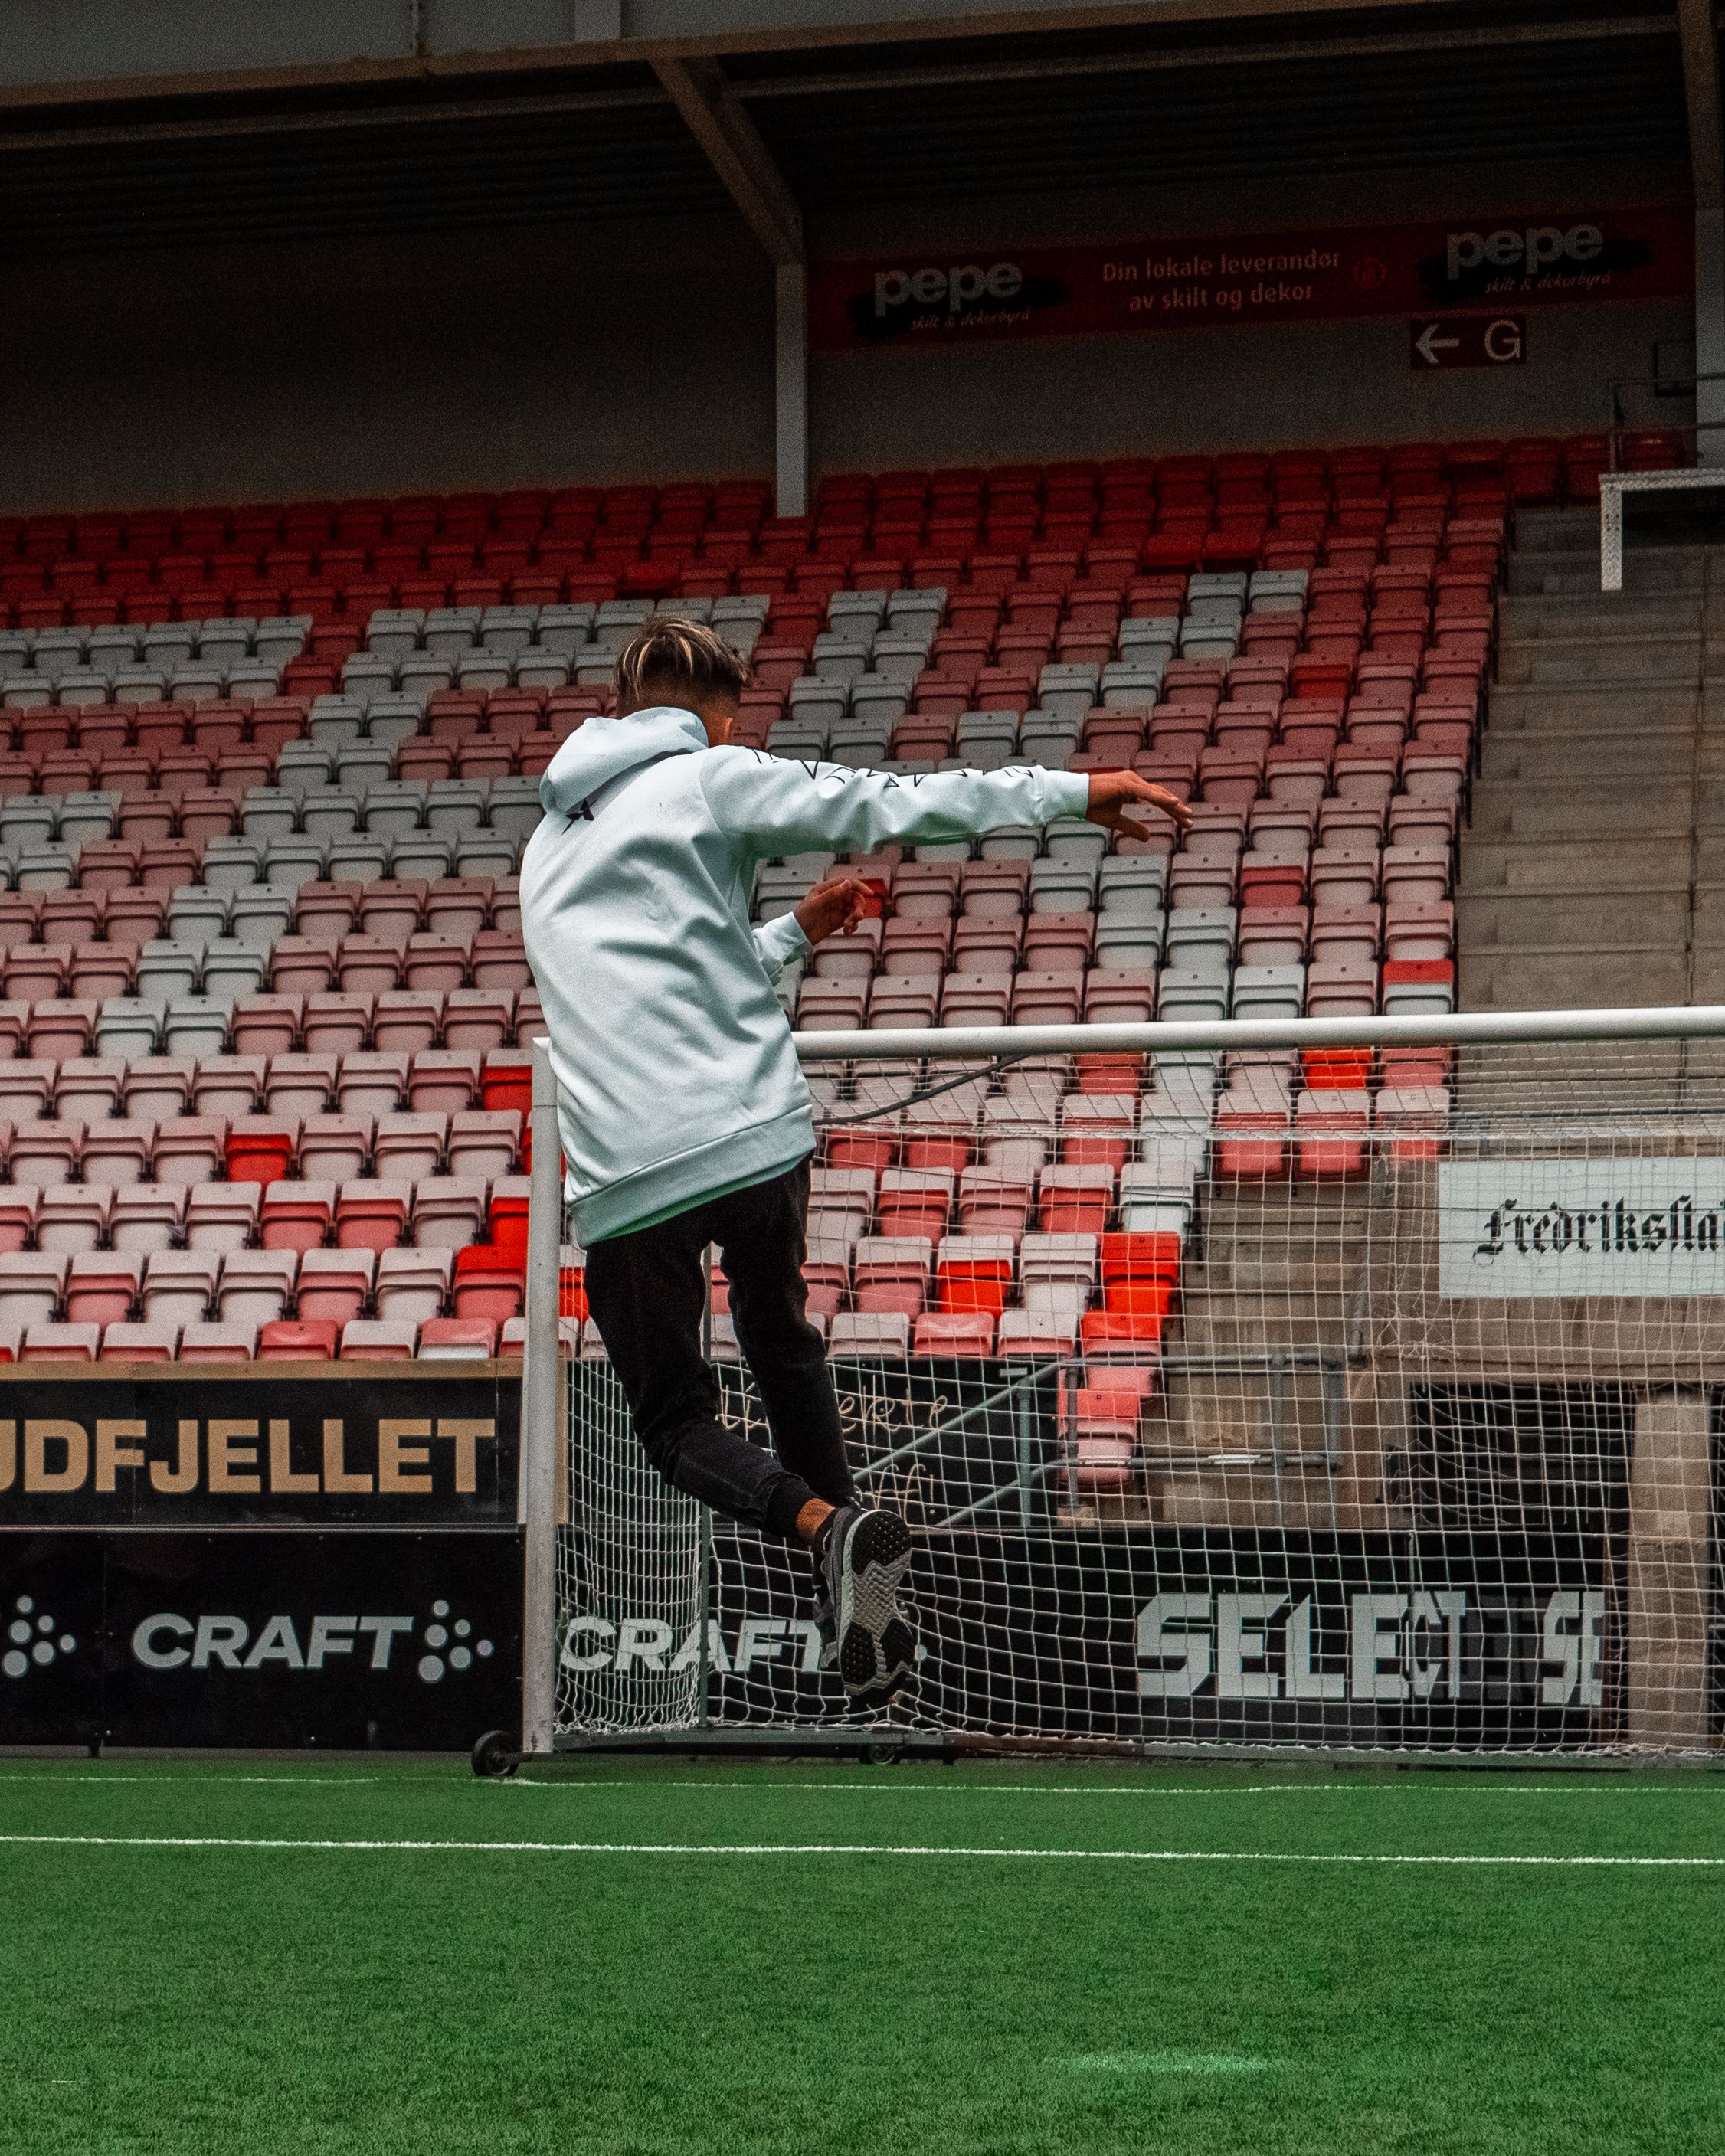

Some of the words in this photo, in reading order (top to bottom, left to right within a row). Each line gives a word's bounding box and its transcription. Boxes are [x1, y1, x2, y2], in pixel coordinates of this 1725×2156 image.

[1103, 261, 1137, 281] Din
[1146, 255, 1212, 279] lokale
[1221, 248, 1340, 274] leverandør
[1447, 224, 1603, 280] pepe
[874, 262, 1023, 318] pepe
[1129, 294, 1154, 312] av
[1162, 287, 1207, 309] skilt
[1216, 288, 1242, 310] og
[1250, 282, 1313, 303] dekor
[1484, 276, 1516, 293] skilt
[1520, 278, 1532, 291] &
[1484, 319, 1521, 361] G
[0, 1418, 496, 1493] DFJELLET
[132, 1612, 414, 1669] CRAFT
[559, 1616, 823, 1672] CRAFT
[1136, 1590, 1467, 1699] SELECT
